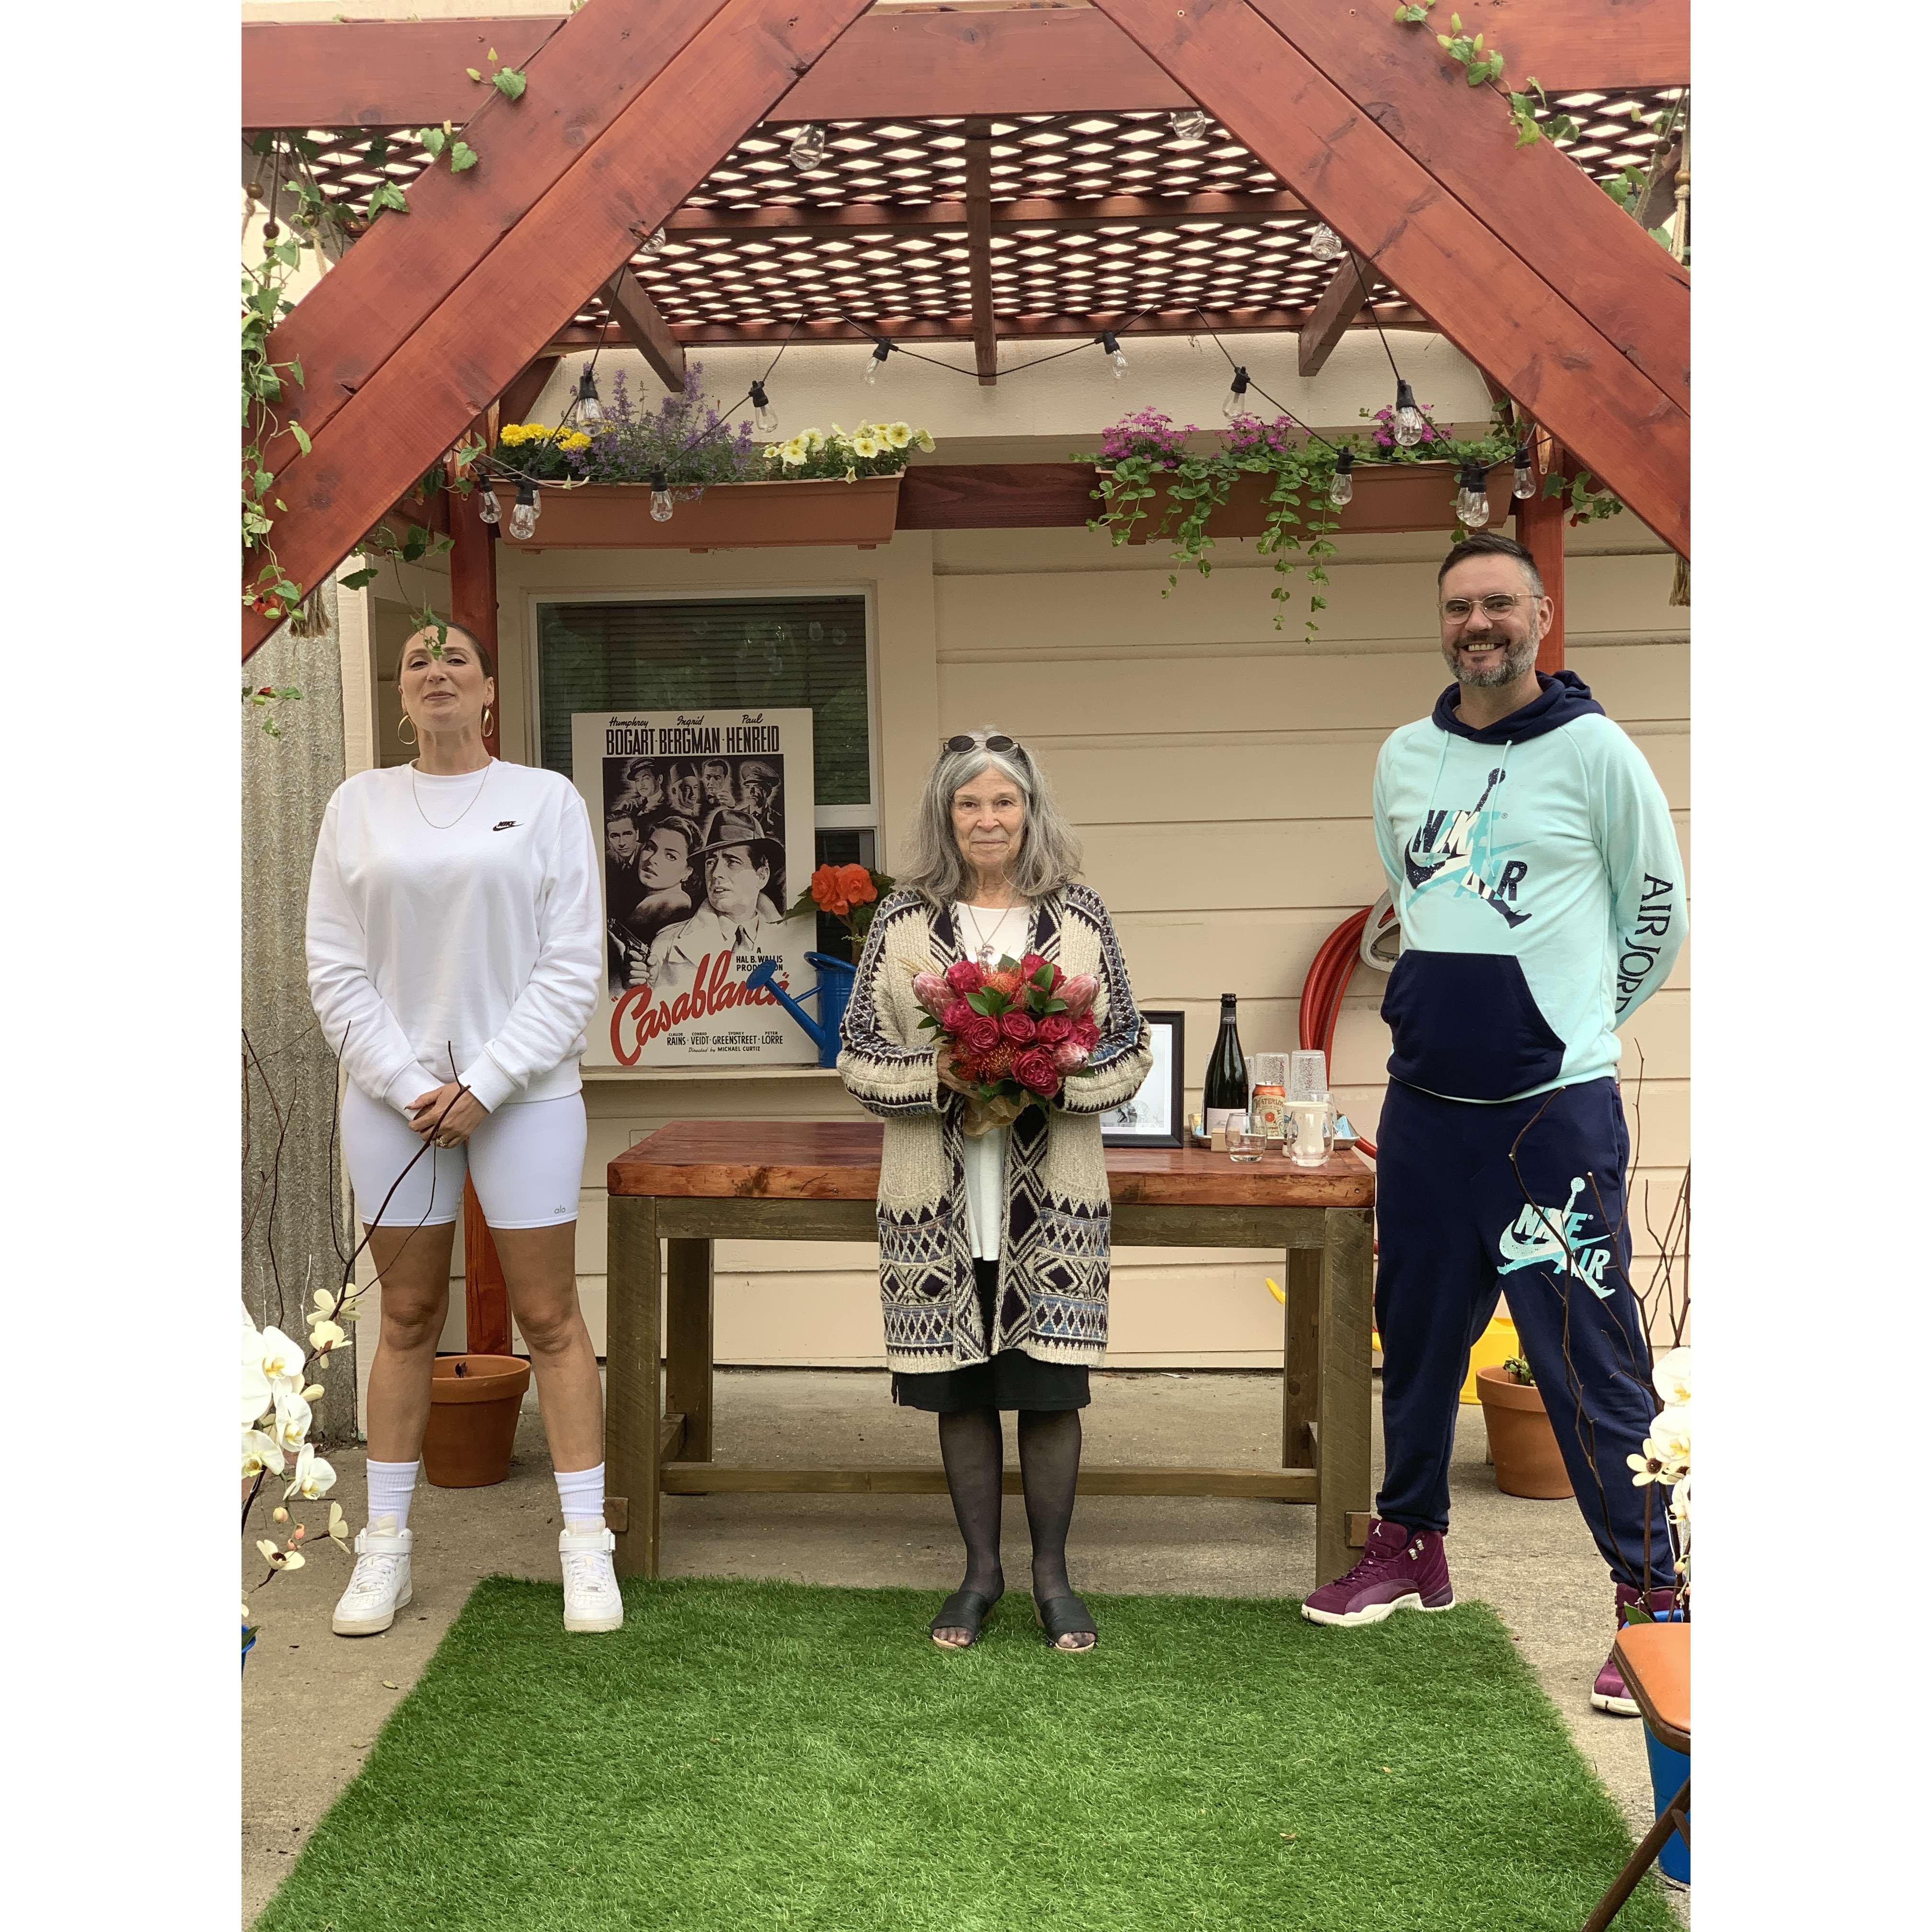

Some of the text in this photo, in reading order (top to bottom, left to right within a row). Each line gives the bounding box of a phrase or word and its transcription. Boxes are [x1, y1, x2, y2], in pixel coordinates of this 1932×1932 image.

[609, 713, 763, 728] Humphrey Ingrid Paul
[606, 725, 779, 755] BOGART BERGMAN HENREID
[1634, 873, 1673, 936] AIR
[667, 1035, 783, 1046] RAINS VEIDT GREENSTREET LORRE
[554, 1205, 565, 1214] alo
